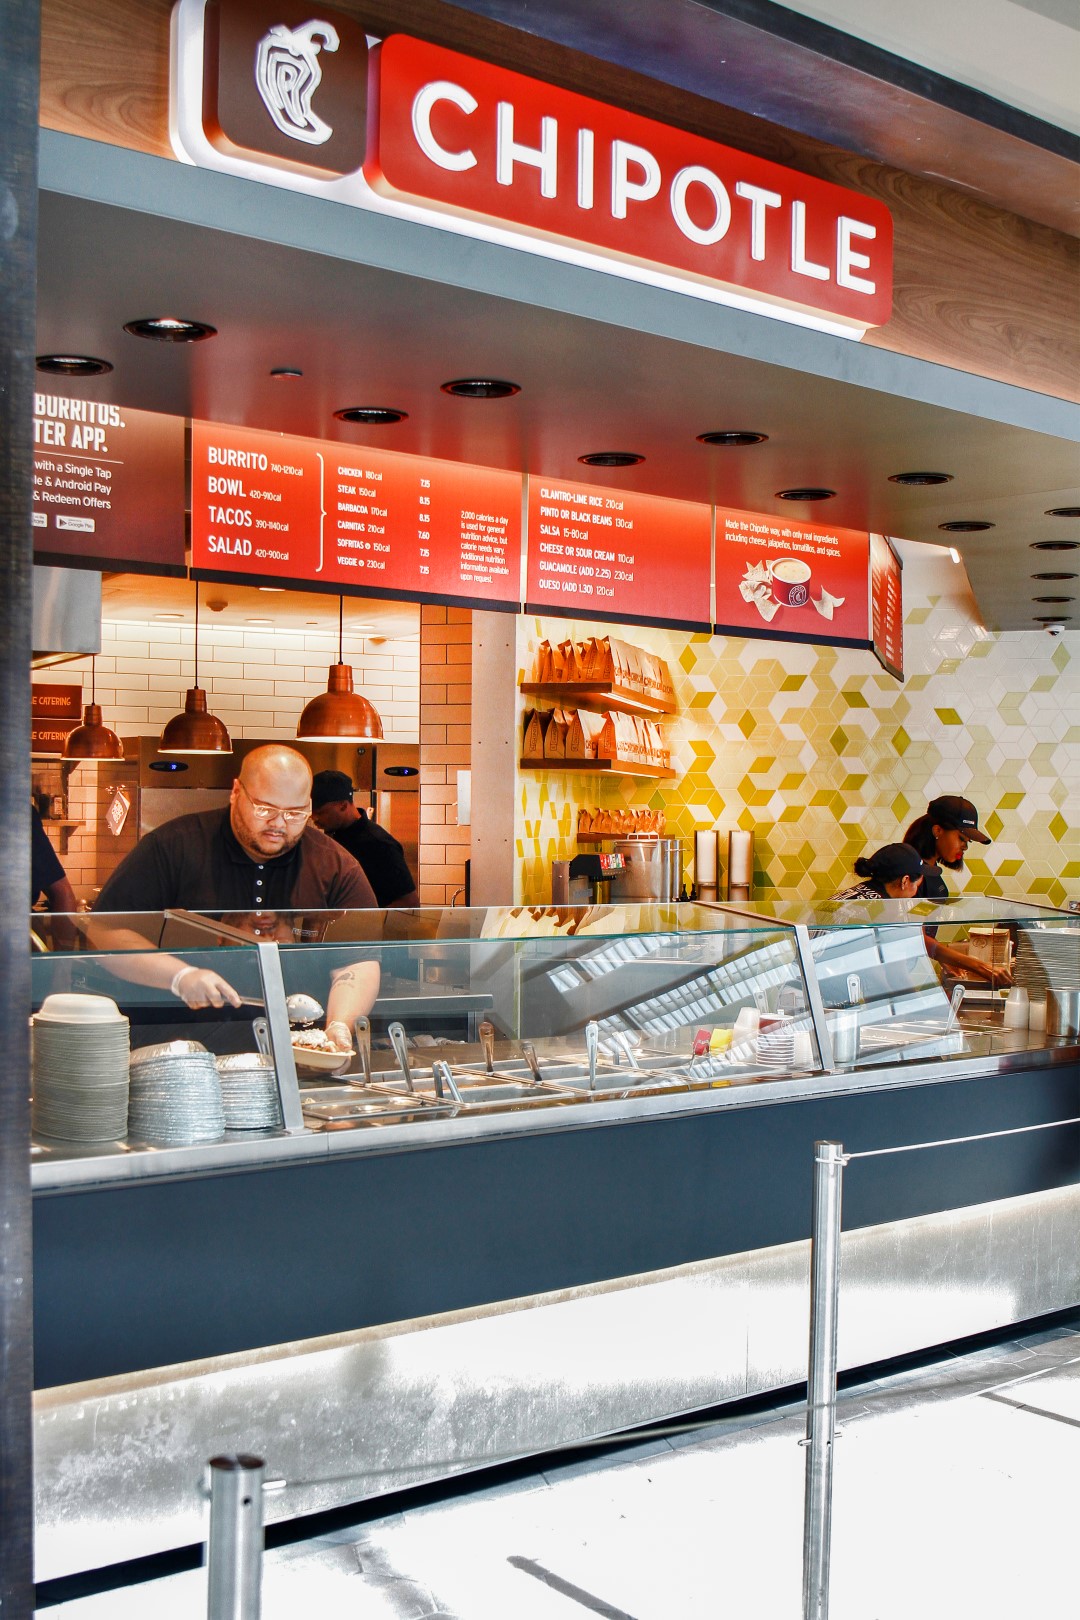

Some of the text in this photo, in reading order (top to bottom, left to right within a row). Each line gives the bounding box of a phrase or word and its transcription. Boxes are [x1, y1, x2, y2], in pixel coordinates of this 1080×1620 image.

[412, 81, 878, 295] CHIPOTLE
[35, 394, 125, 428] BURRITOS.
[71, 425, 108, 452] APP.
[208, 446, 268, 471] BURRITO
[35, 460, 111, 479] with a Single Tap
[338, 466, 362, 478] CHICKEN
[45, 477, 52, 486] &
[55, 478, 92, 491] Android
[94, 483, 111, 495] Pay
[208, 476, 246, 497] BOWL
[338, 485, 356, 494] STEAK
[33, 491, 111, 509] & Redeem Offers
[541, 488, 587, 504] CILANTRO-LIME
[589, 496, 602, 507] RICE
[208, 506, 252, 527] TACOS
[338, 503, 368, 514] BARBACOA
[541, 506, 558, 518] PINTO
[561, 510, 569, 519] OR
[571, 512, 591, 523] BLACK
[592, 514, 612, 526] BEANS
[338, 521, 365, 531] CARNITAS
[500, 517, 508, 526] day
[541, 525, 560, 536] SALSA
[726, 519, 739, 529] Made
[740, 522, 748, 530] the
[750, 523, 769, 534] Chipotle
[782, 528, 791, 537] with
[793, 531, 802, 541] only
[814, 533, 838, 544] ingredients
[726, 532, 748, 545] including
[208, 535, 252, 556] SALAD
[338, 539, 363, 549] SOFRITAS
[540, 543, 564, 554] CHEESE
[565, 546, 574, 555] OR
[576, 548, 592, 558] SOUR
[594, 551, 615, 561] CREAM
[338, 556, 357, 566] VEGGIE
[540, 561, 577, 574] GUACAMOLE
[579, 566, 594, 577] (ADD
[596, 568, 611, 579] 2.25)
[539, 579, 560, 590] QUESO
[562, 582, 577, 592] (ADD
[579, 584, 593, 595] 1.30)
[39, 697, 71, 706] CATERING
